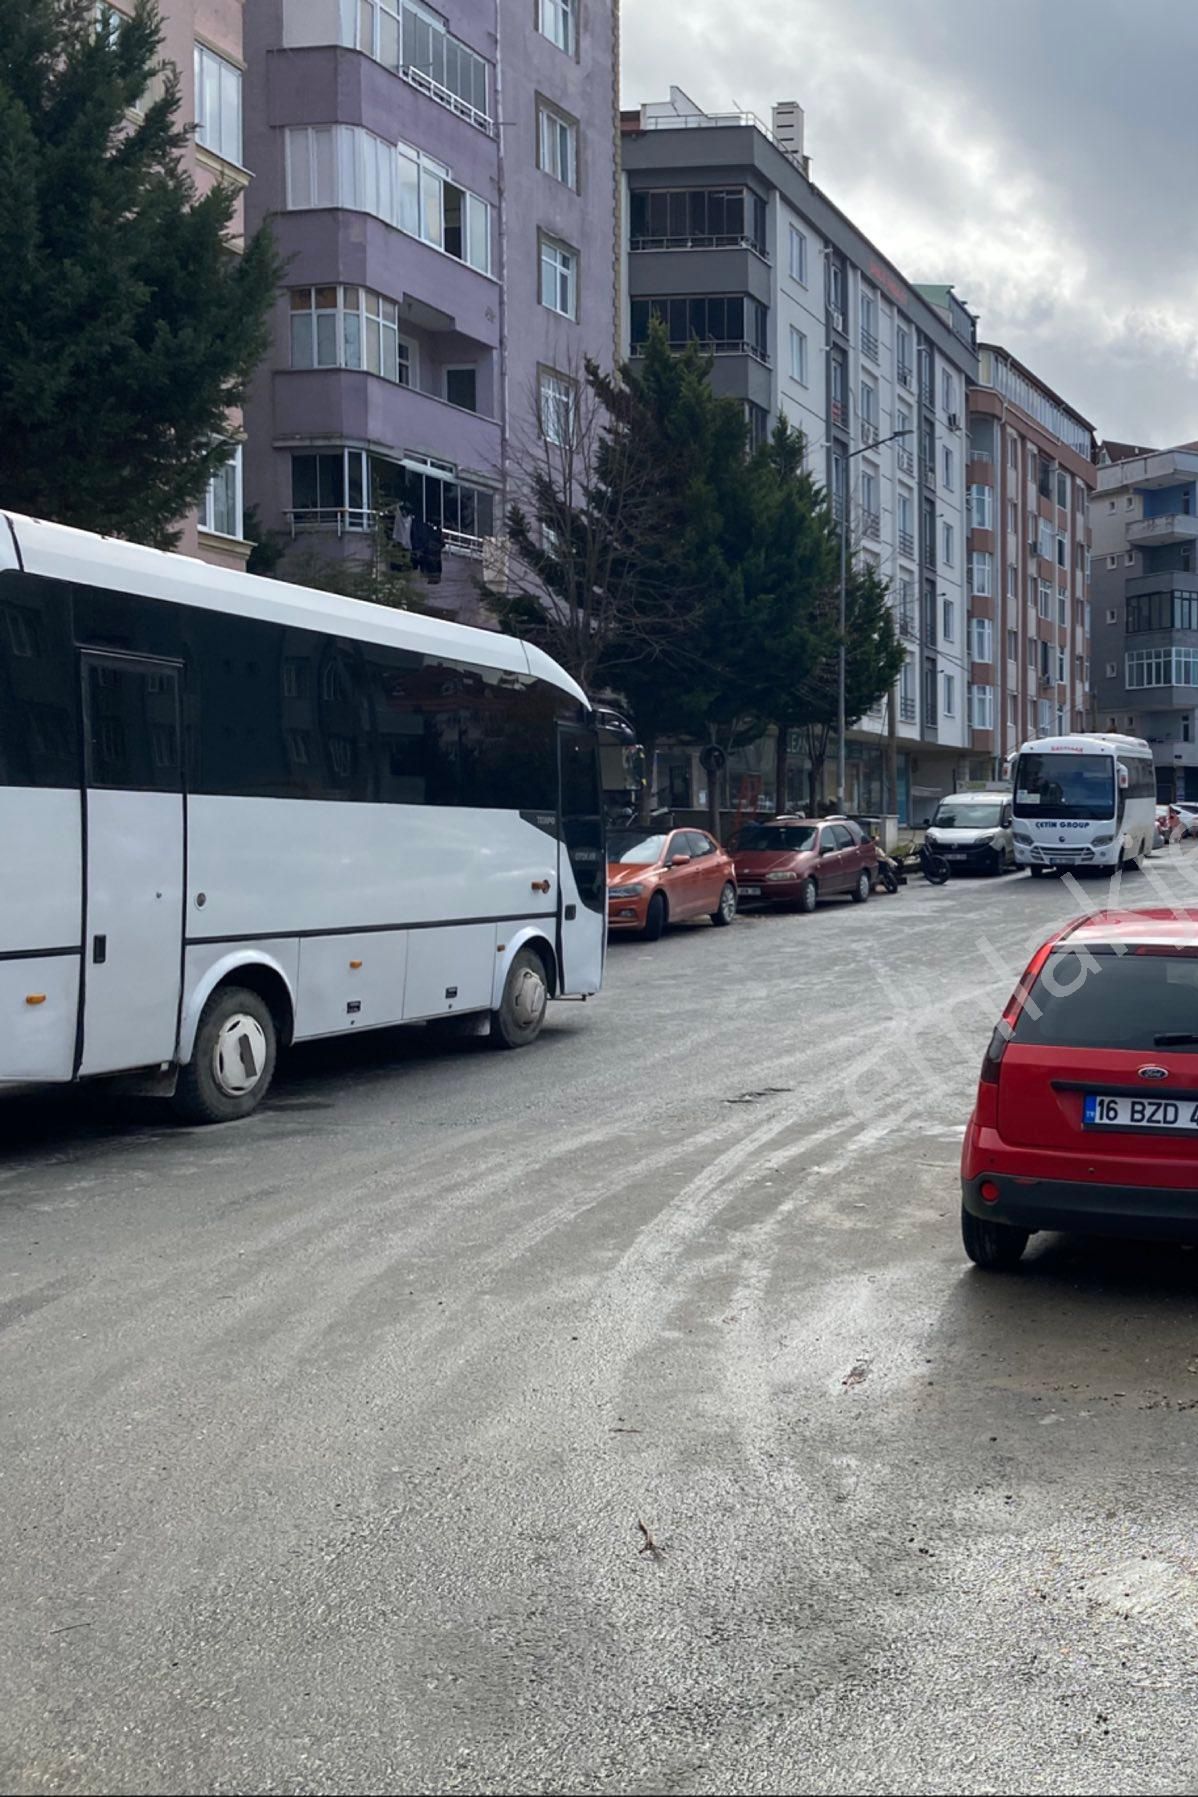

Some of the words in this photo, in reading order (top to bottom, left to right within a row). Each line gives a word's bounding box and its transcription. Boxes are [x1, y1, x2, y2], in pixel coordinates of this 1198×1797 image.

[1059, 821, 1090, 829] GROUP
[1098, 1099, 1118, 1121] 16
[1130, 1100, 1179, 1125] BZD
